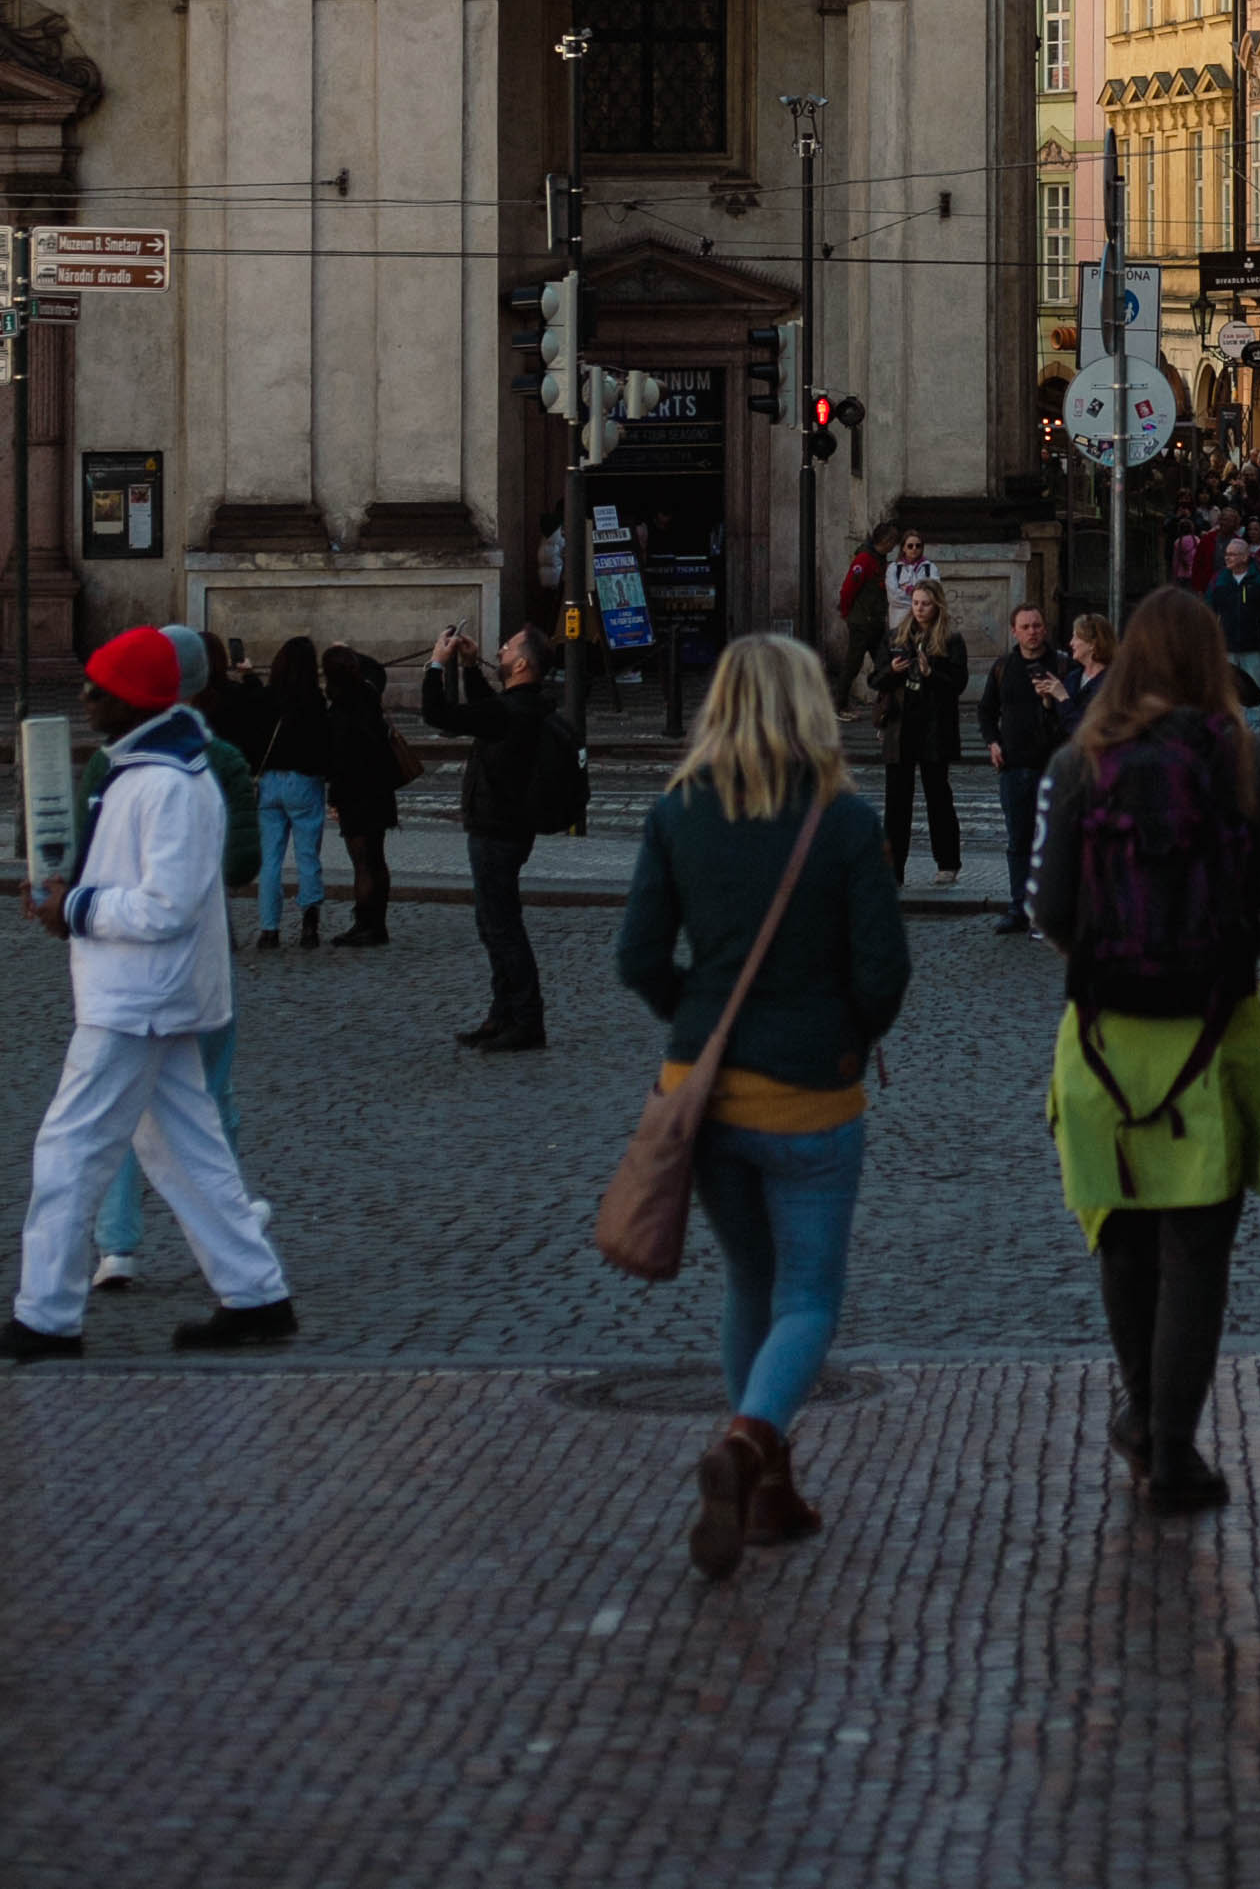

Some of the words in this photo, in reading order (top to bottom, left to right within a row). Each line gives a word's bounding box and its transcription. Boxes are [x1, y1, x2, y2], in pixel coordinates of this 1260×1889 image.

[59, 236, 94, 251] Muzeum
[95, 236, 103, 251] B.
[104, 237, 142, 255] Smetany
[58, 267, 95, 283] Národní
[97, 268, 132, 284] divadlo
[1215, 277, 1245, 285] DIVADLO
